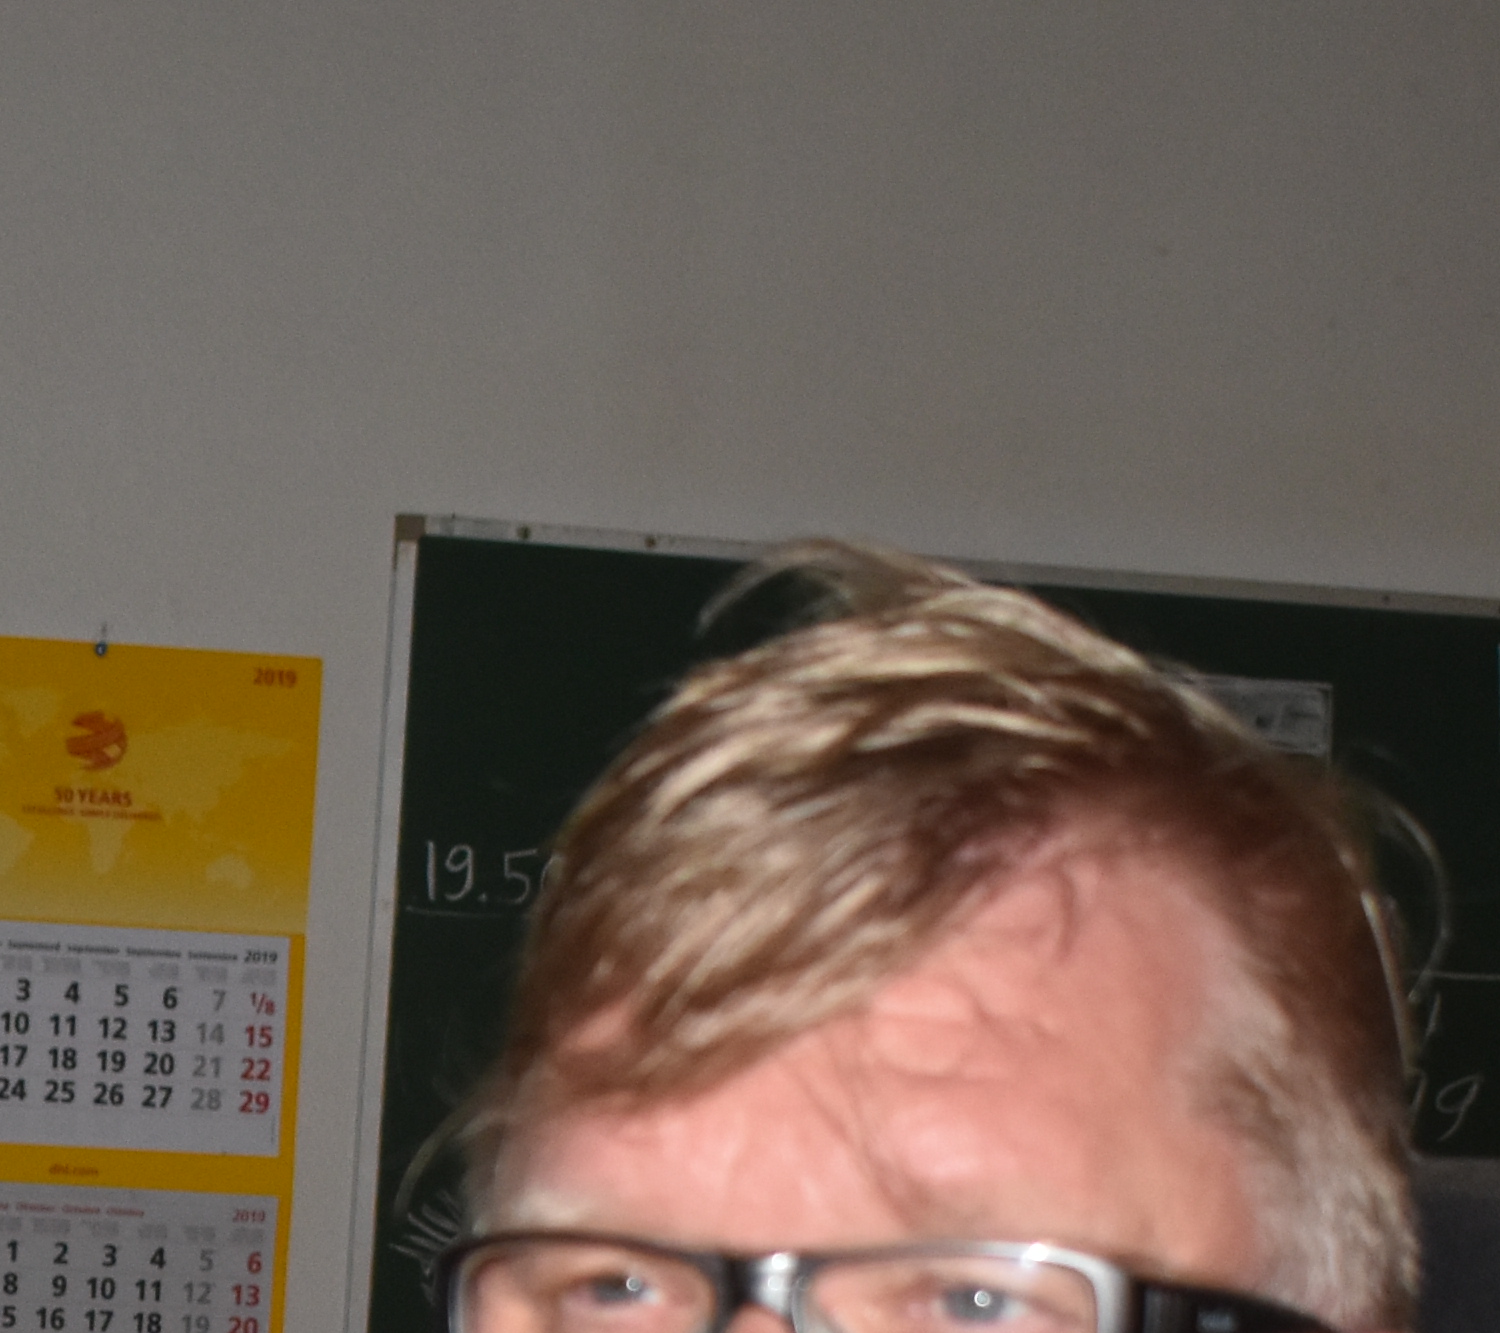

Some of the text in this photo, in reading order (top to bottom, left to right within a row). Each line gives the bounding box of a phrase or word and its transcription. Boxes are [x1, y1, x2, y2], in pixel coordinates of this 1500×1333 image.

[253, 667, 298, 688] 2019
[54, 788, 132, 807] 50 YEARS
[244, 949, 278, 964] 2019
[16, 978, 31, 1002] 3
[64, 982, 80, 1004] 4
[115, 984, 129, 1007] 5
[163, 987, 178, 1010] 6
[213, 989, 227, 1012] 7
[1, 1011, 30, 1034] 10
[50, 1014, 76, 1037] 11
[99, 1017, 127, 1040] 12
[148, 1020, 176, 1043] 13
[197, 1022, 225, 1045] 14
[245, 1025, 273, 1048] 15
[0, 1044, 28, 1067] 17
[49, 1047, 77, 1070] 18
[97, 1050, 126, 1073] 19
[144, 1052, 175, 1076] 20
[192, 1055, 222, 1078] 21
[241, 1058, 271, 1081] 22
[44, 1079, 75, 1103] 25
[93, 1082, 124, 1106] 26
[142, 1085, 173, 1108] 27
[190, 1087, 222, 1111] 28
[239, 1090, 270, 1114] 29
[232, 1208, 266, 1223] 2019
[7, 1240, 262, 1275] 1 2 3 4 5 6
[3, 1272, 18, 1295] 8
[52, 1275, 67, 1297] 9
[87, 1277, 116, 1300] 10
[136, 1279, 161, 1302] 11
[184, 1281, 215, 1305] 12
[232, 1284, 260, 1307] 13
[36, 1307, 65, 1331] 16
[85, 1310, 114, 1332] 17
